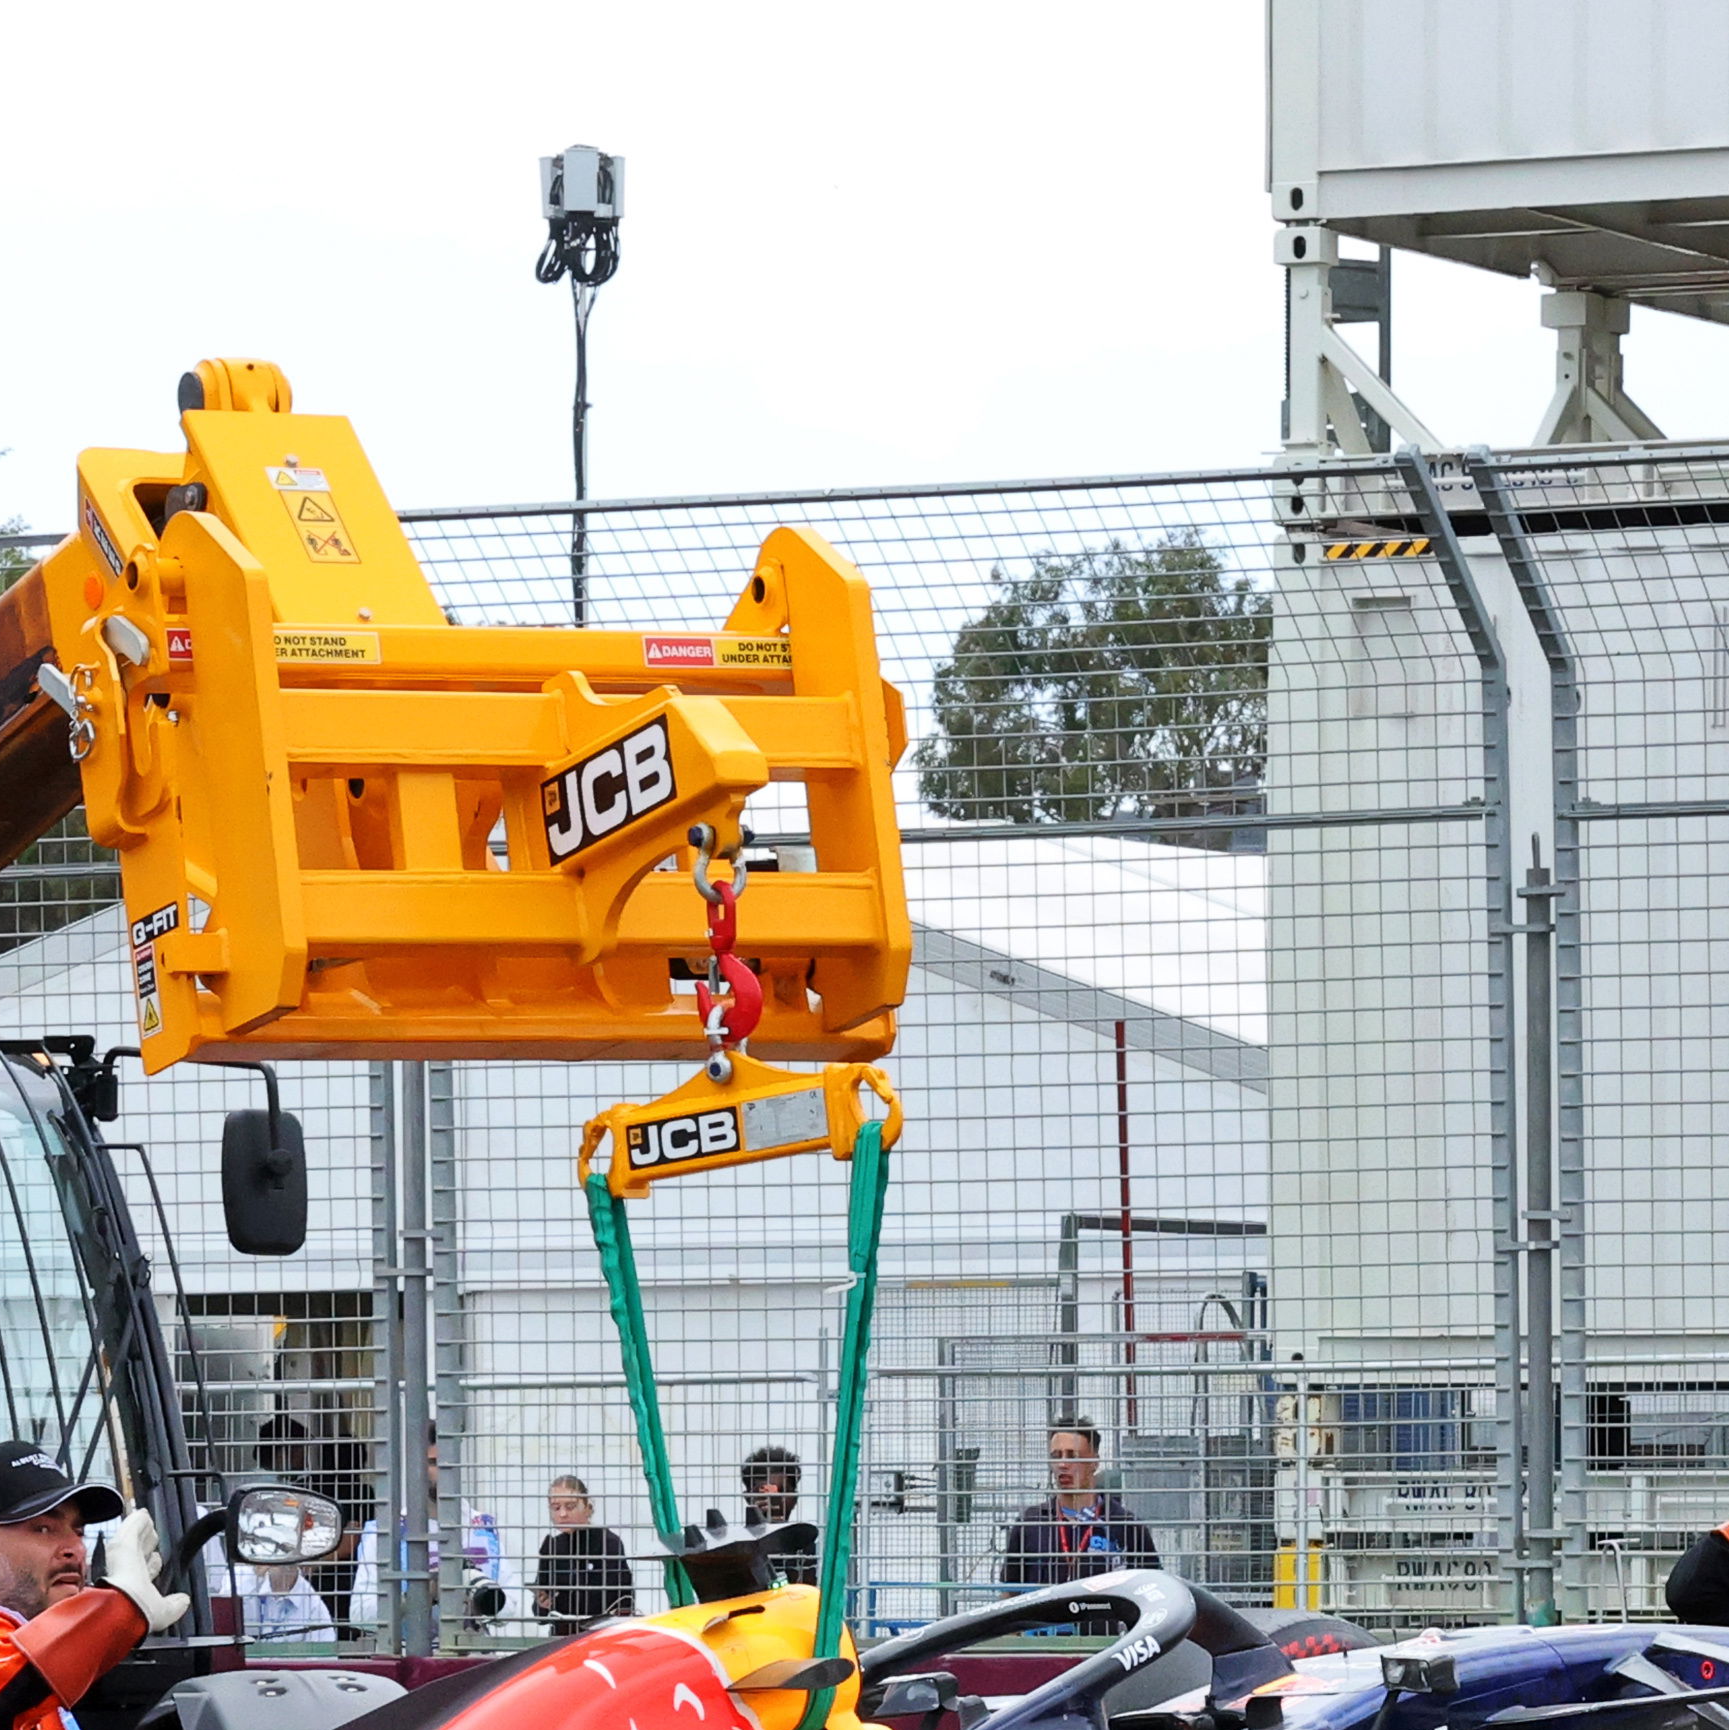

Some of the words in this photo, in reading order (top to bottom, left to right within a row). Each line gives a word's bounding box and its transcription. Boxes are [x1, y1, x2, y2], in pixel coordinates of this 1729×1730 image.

[284, 636, 307, 646] NOT
[309, 636, 347, 647] STAND
[738, 642, 754, 652] DO
[756, 642, 778, 653] NOT
[289, 648, 366, 660] ATTACHMENT
[662, 645, 713, 659] DANGER
[722, 654, 760, 664] UNDER
[548, 723, 673, 857] JCB
[132, 903, 178, 947] Q-FIT
[630, 1111, 738, 1166] JCB
[1111, 1634, 1161, 1672] VISA
